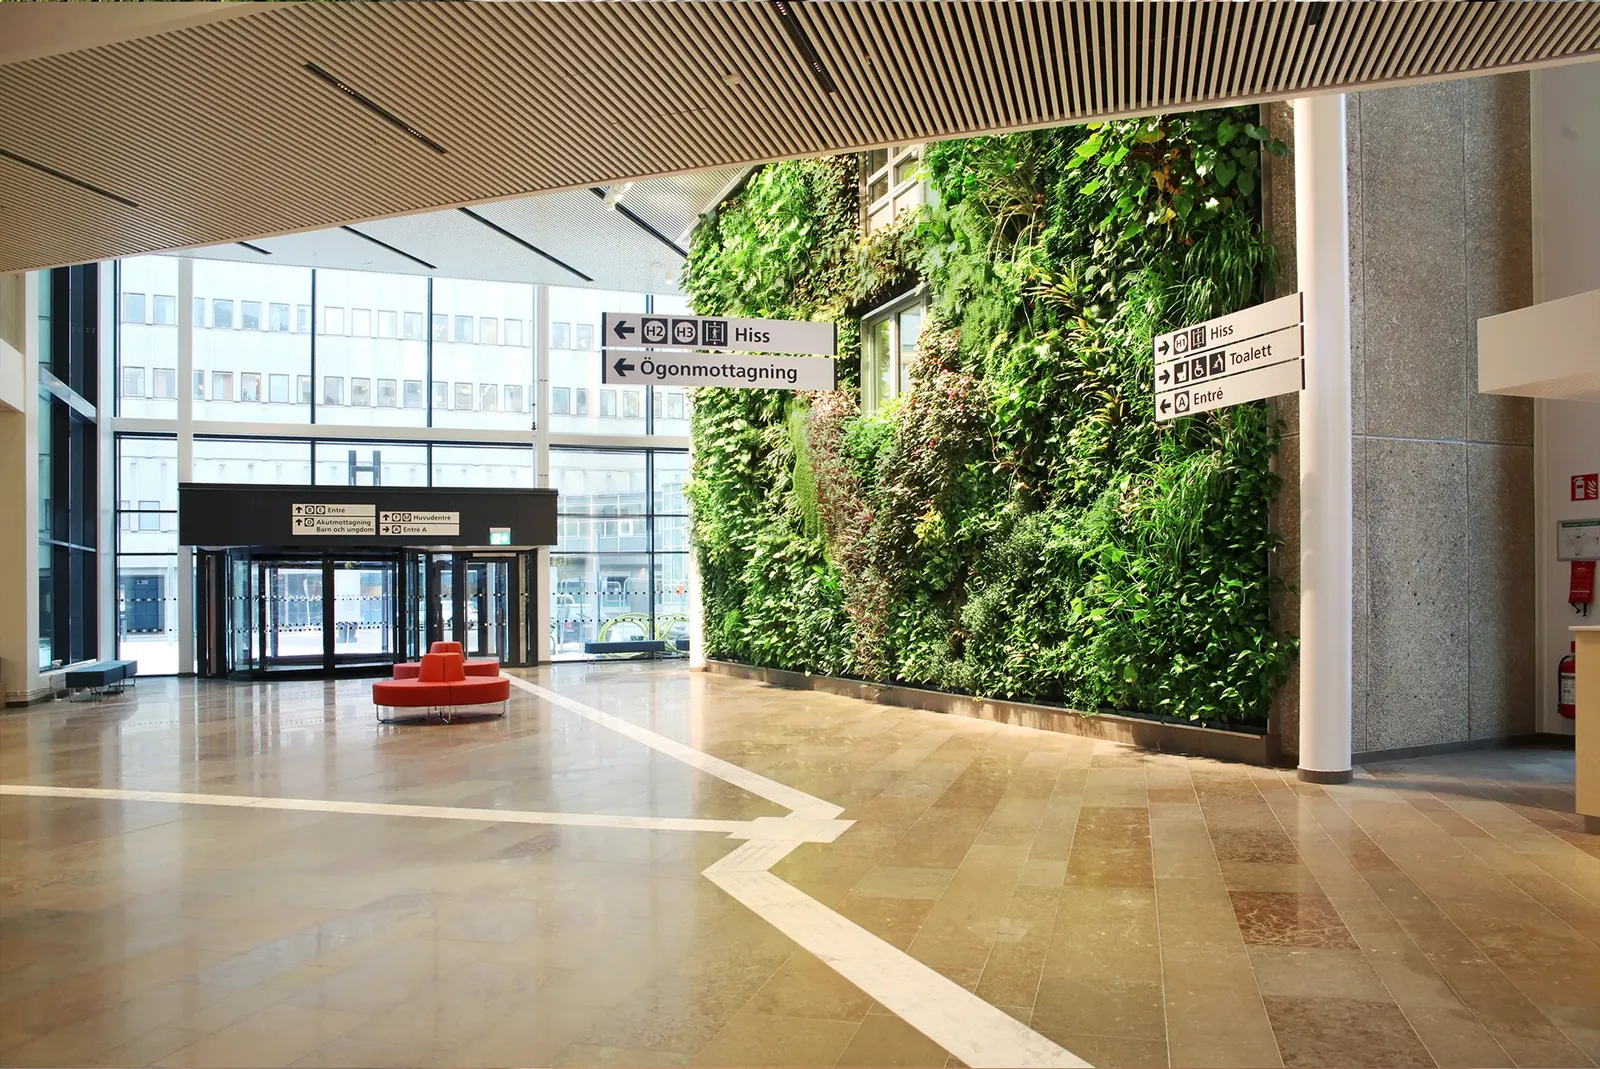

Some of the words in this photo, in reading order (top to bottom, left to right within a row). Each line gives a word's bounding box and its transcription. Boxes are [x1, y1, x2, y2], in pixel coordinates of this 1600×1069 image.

[646, 326, 664, 336] H2
[676, 326, 694, 338] H3
[735, 327, 770, 343] Hiss
[1176, 338, 1186, 348] H1
[1210, 324, 1234, 340] Hiss
[1230, 344, 1272, 365] Toalett
[640, 356, 797, 383] Ögonmottagning
[1194, 387, 1224, 405] Entré
